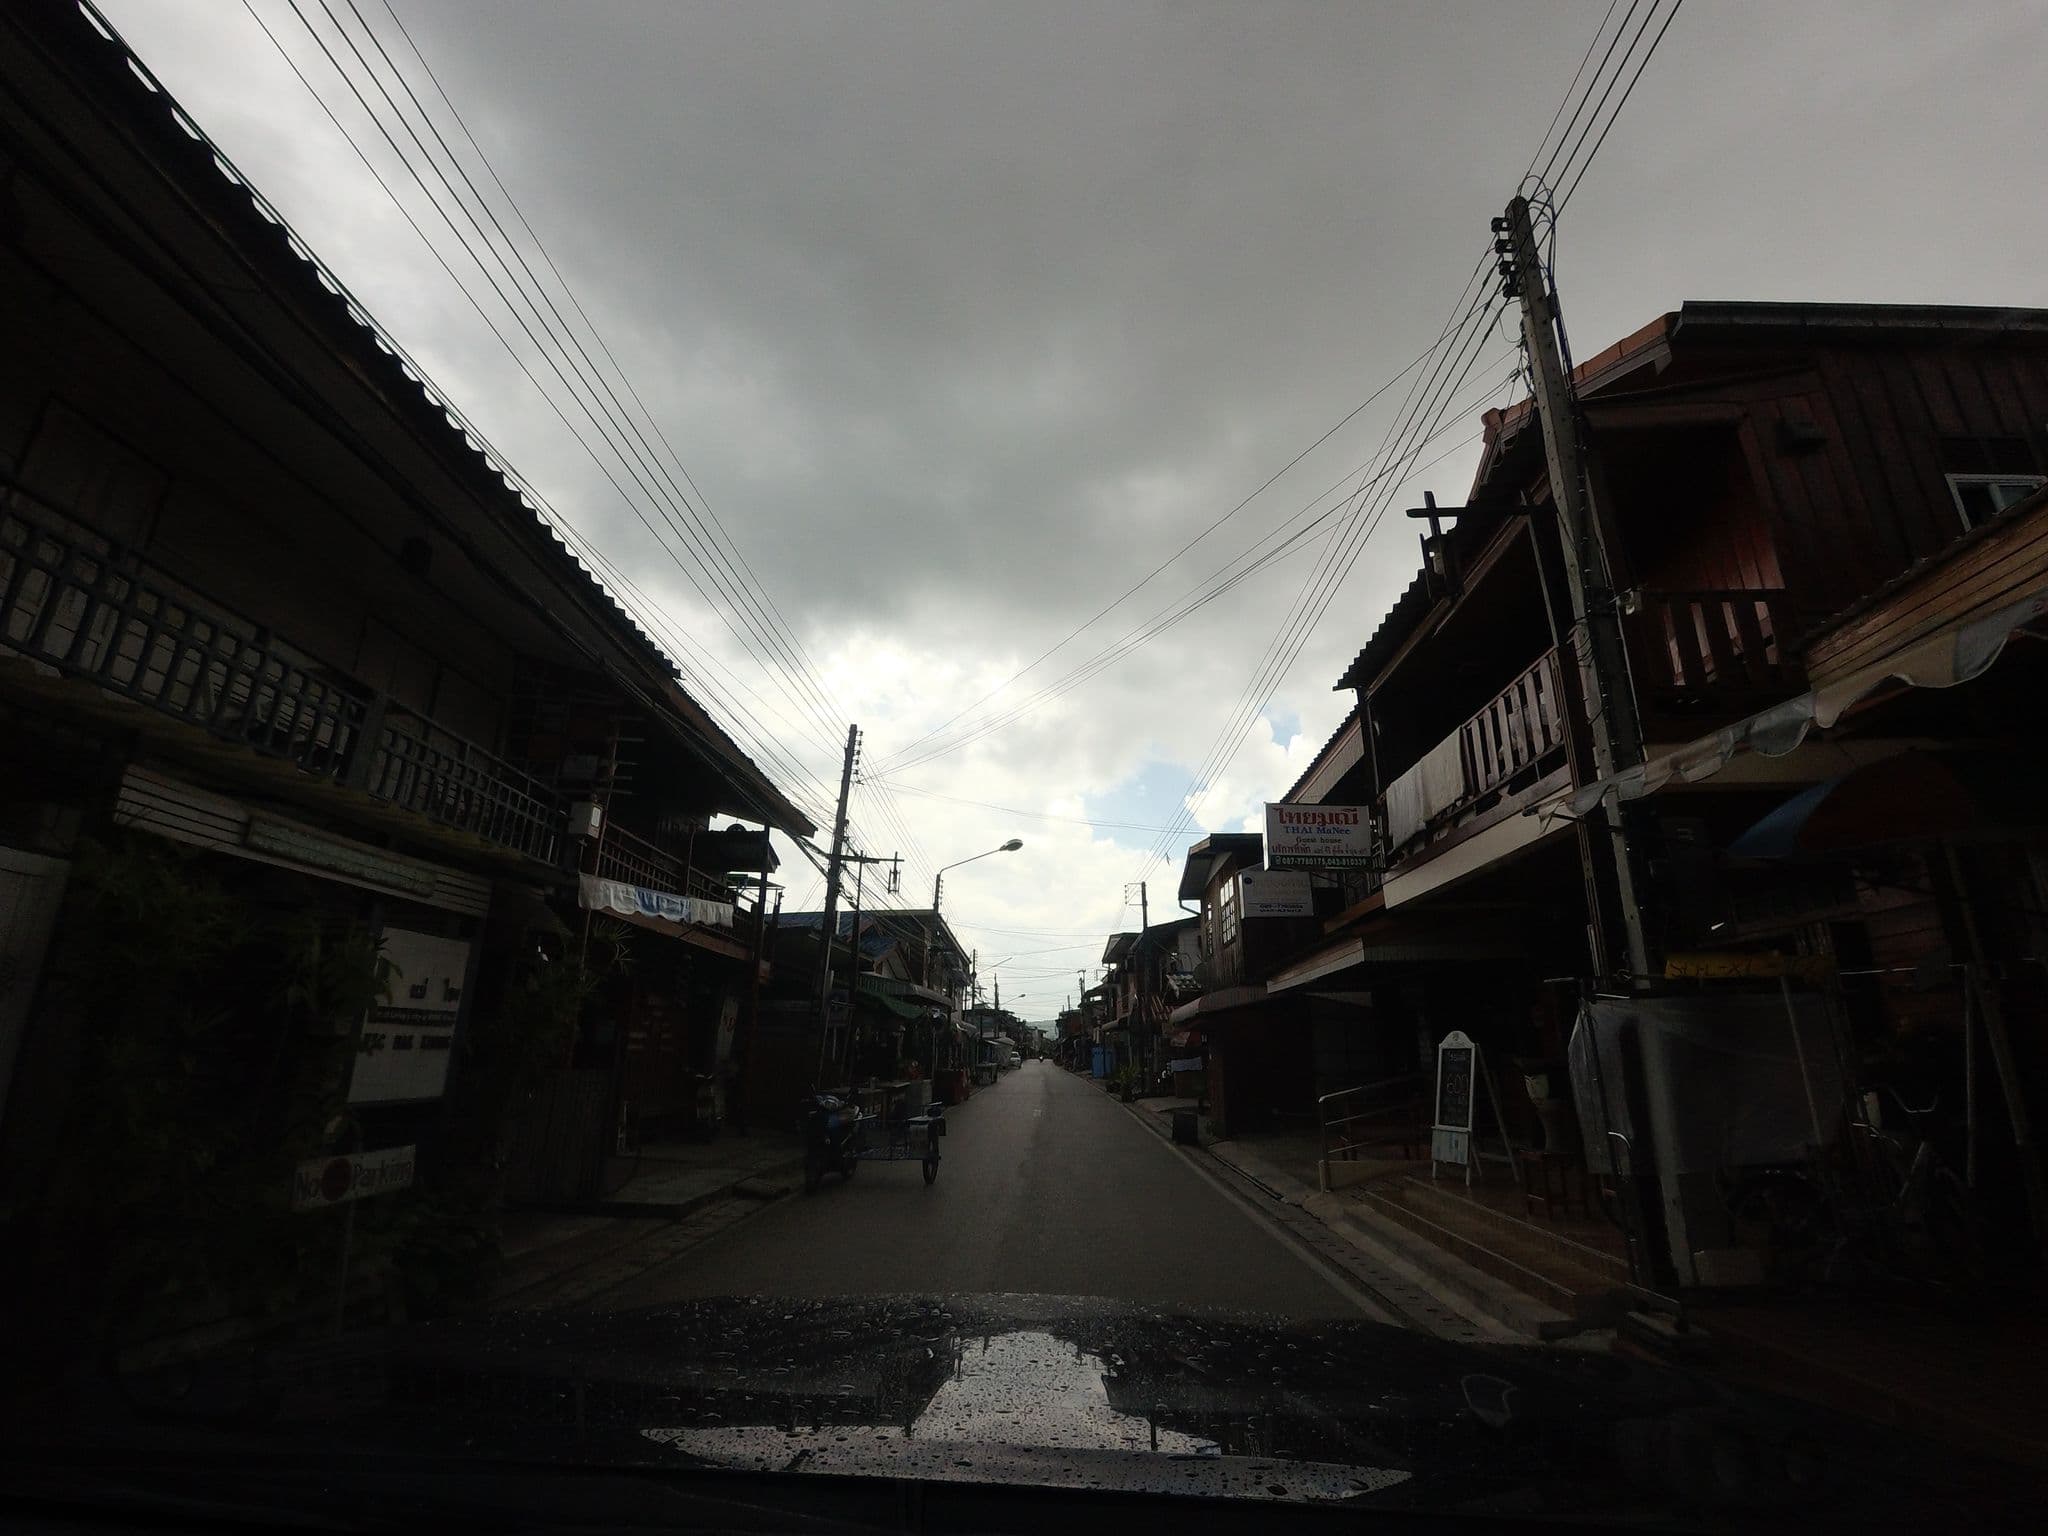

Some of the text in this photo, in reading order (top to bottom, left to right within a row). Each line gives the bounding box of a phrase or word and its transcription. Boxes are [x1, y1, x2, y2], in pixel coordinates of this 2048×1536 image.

[1272, 807, 1360, 826] ไทยมณี
[1285, 826, 1313, 834] THAI
